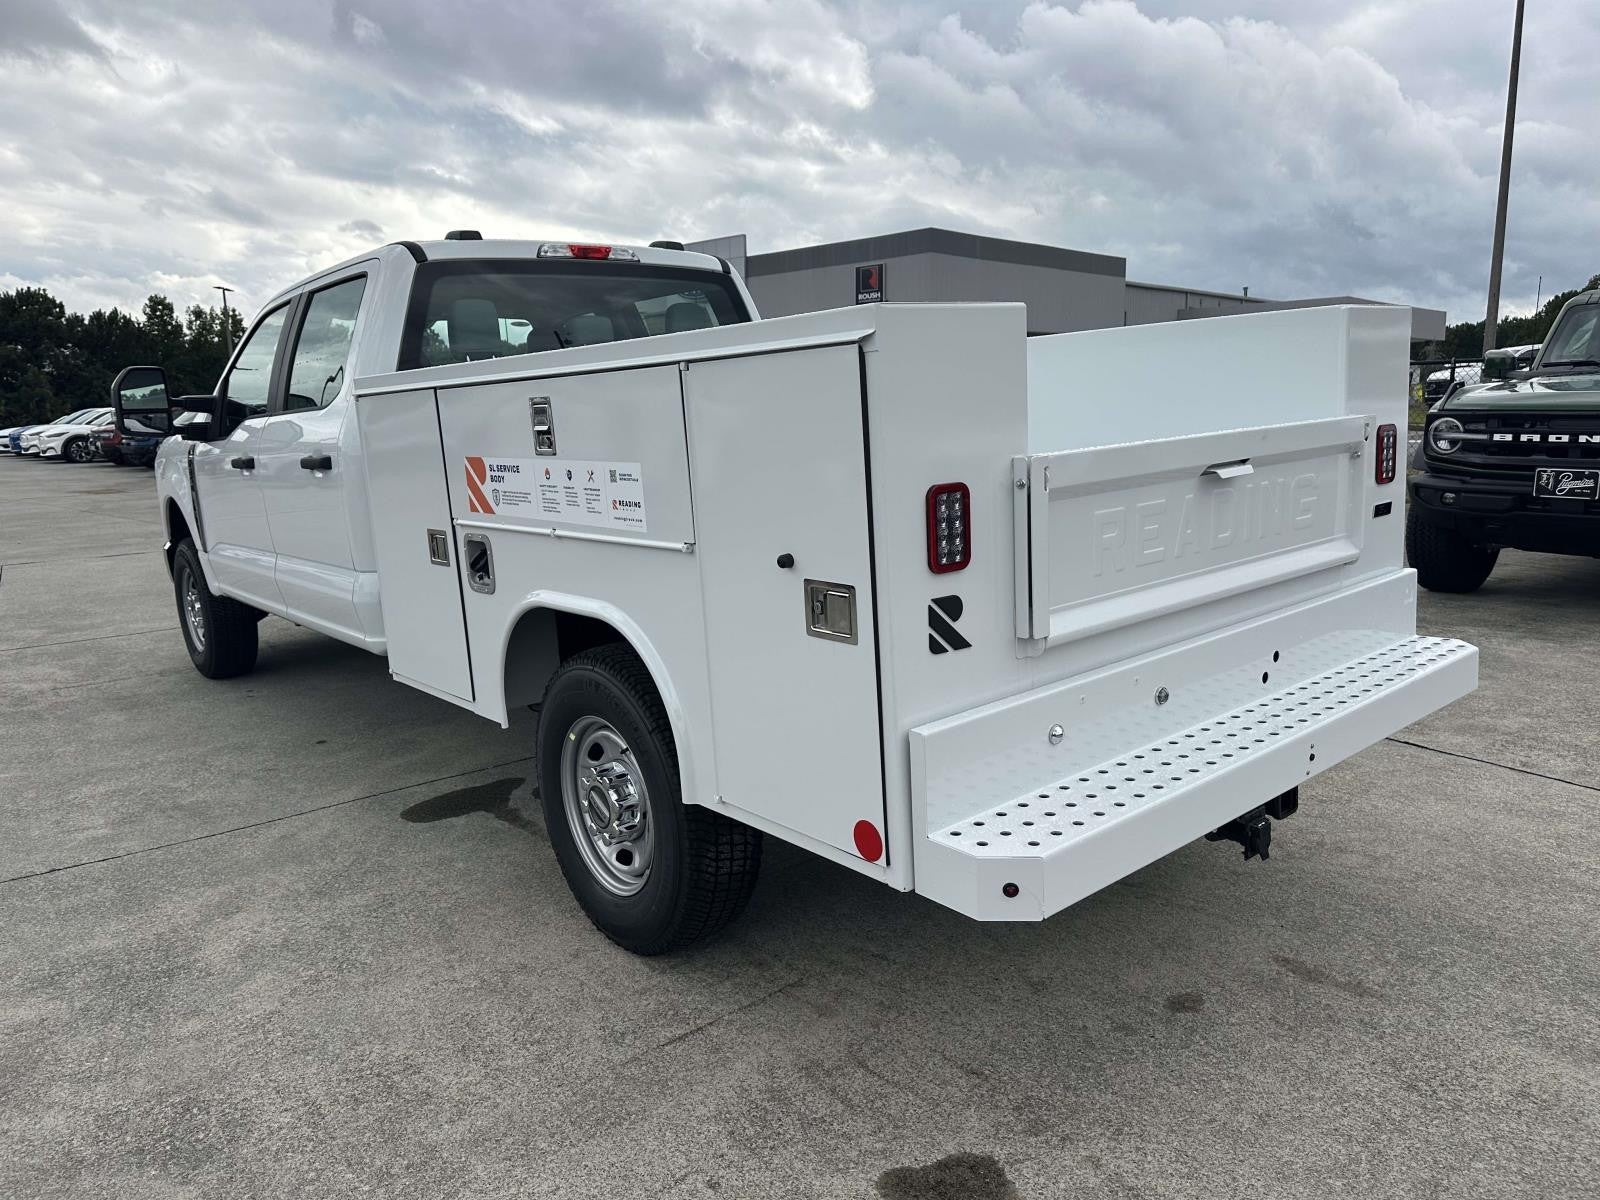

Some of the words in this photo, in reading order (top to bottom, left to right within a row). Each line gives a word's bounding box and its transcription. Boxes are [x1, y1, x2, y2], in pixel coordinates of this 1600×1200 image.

[858, 292, 881, 301] ROUSH
[488, 464, 496, 473] SL
[496, 464, 521, 474] SERVICE
[490, 474, 505, 484] BODY
[618, 500, 642, 509] READING
[1092, 472, 1319, 578] READING
